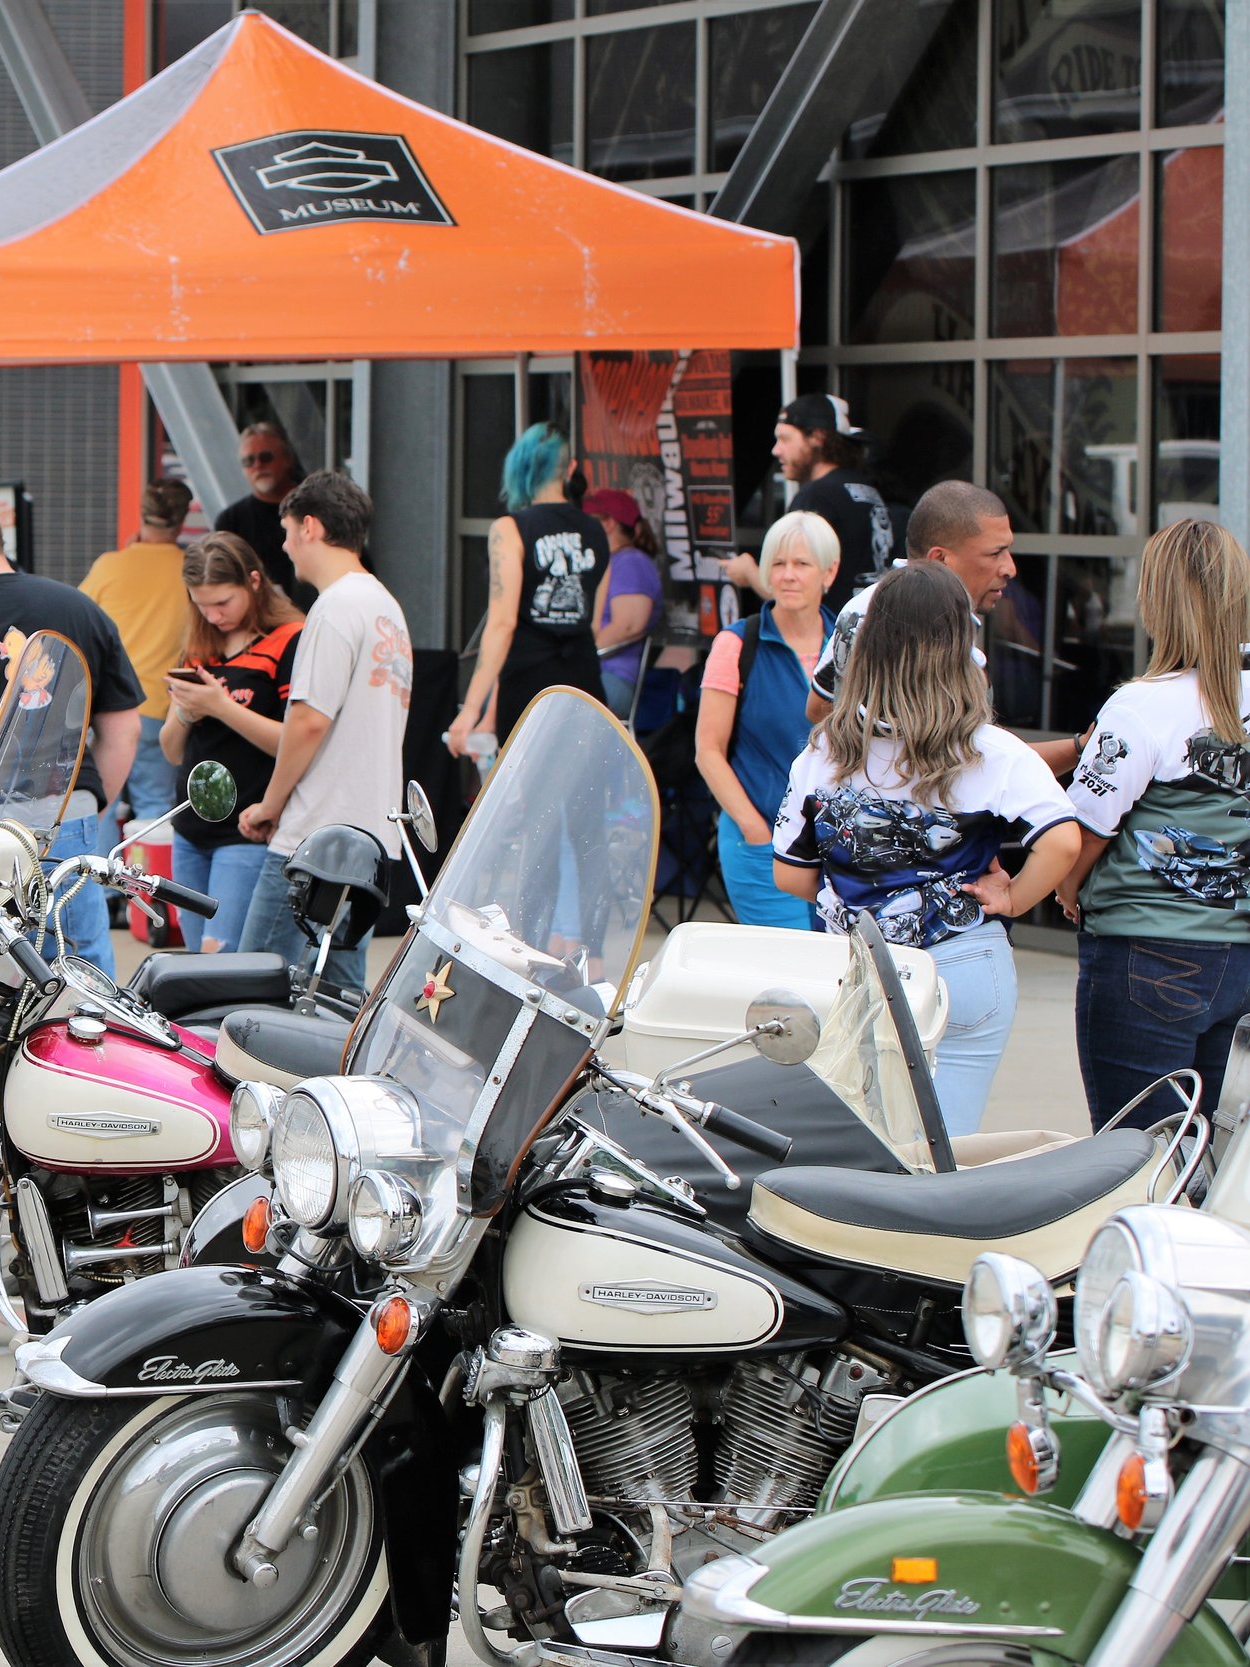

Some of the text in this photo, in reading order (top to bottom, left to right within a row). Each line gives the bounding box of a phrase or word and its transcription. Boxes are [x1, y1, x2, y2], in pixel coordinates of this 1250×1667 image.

[278, 197, 419, 221] MUSEUM
[1078, 774, 1109, 798] 2021
[61, 1119, 148, 1130] HARLEY-DAVIDSON
[598, 1290, 701, 1302] HARLEY-DAVIDSON
